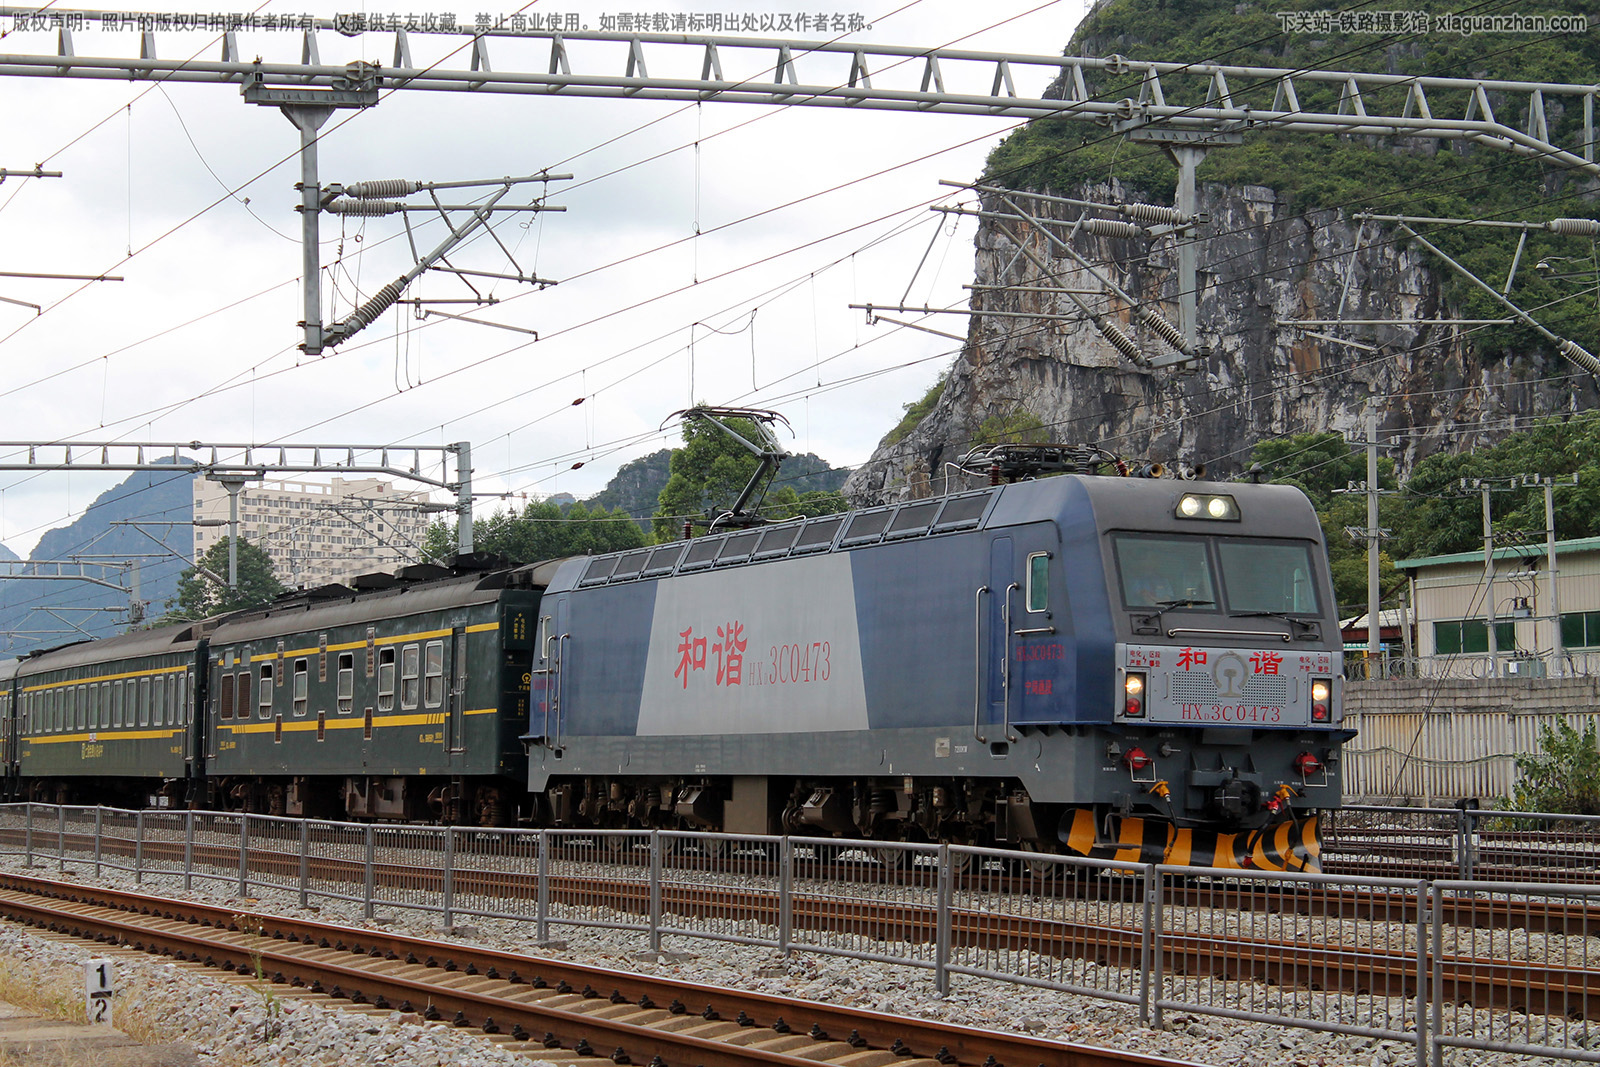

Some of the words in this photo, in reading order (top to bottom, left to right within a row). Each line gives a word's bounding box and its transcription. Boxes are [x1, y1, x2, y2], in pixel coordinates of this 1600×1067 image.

[674, 620, 748, 690] 和谐
[96, 964, 106, 988] 1
[95, 999, 108, 1023] 2
